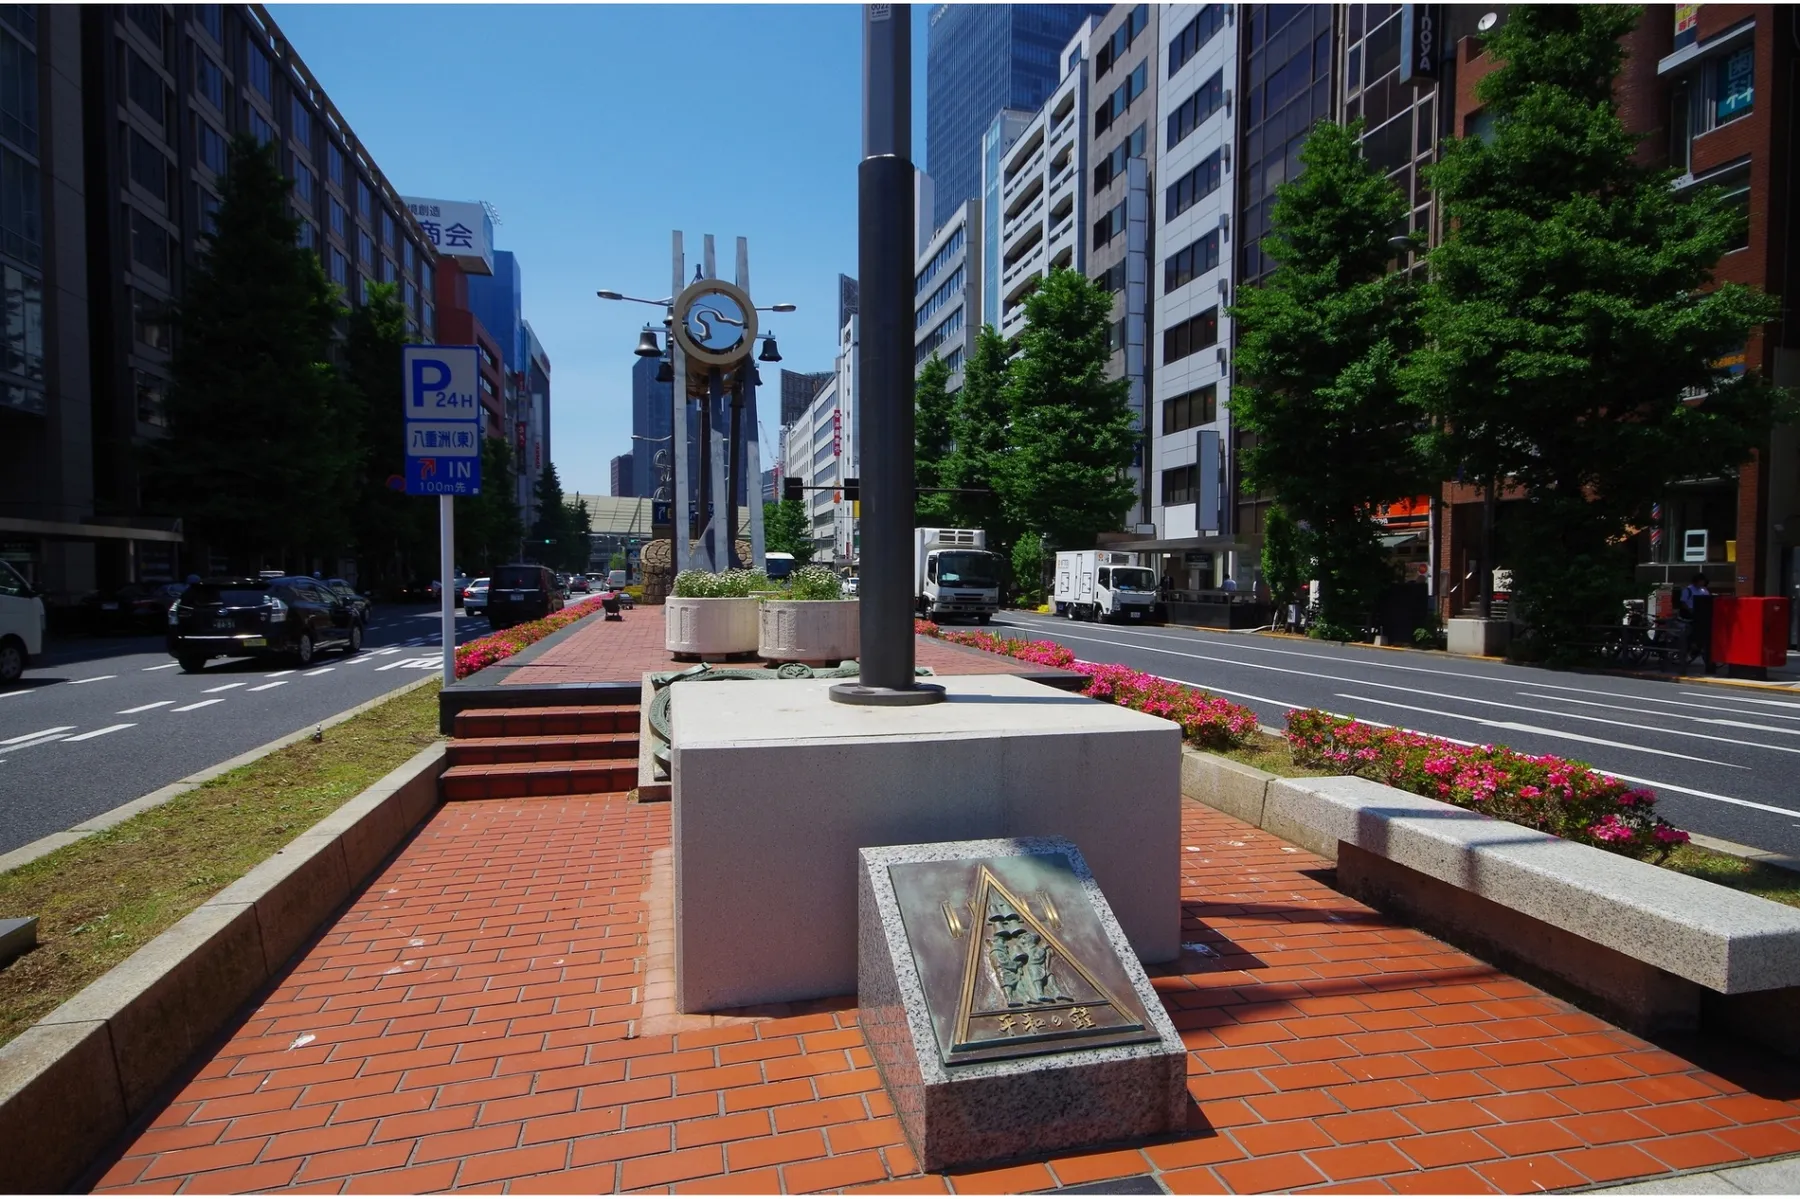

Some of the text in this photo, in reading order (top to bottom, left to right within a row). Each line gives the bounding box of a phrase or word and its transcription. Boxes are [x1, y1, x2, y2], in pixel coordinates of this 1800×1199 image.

[412, 359, 473, 408] P 24H
[413, 430, 474, 448] 八重洲(東)
[449, 461, 471, 478] IN
[420, 482, 466, 492] 100m先
